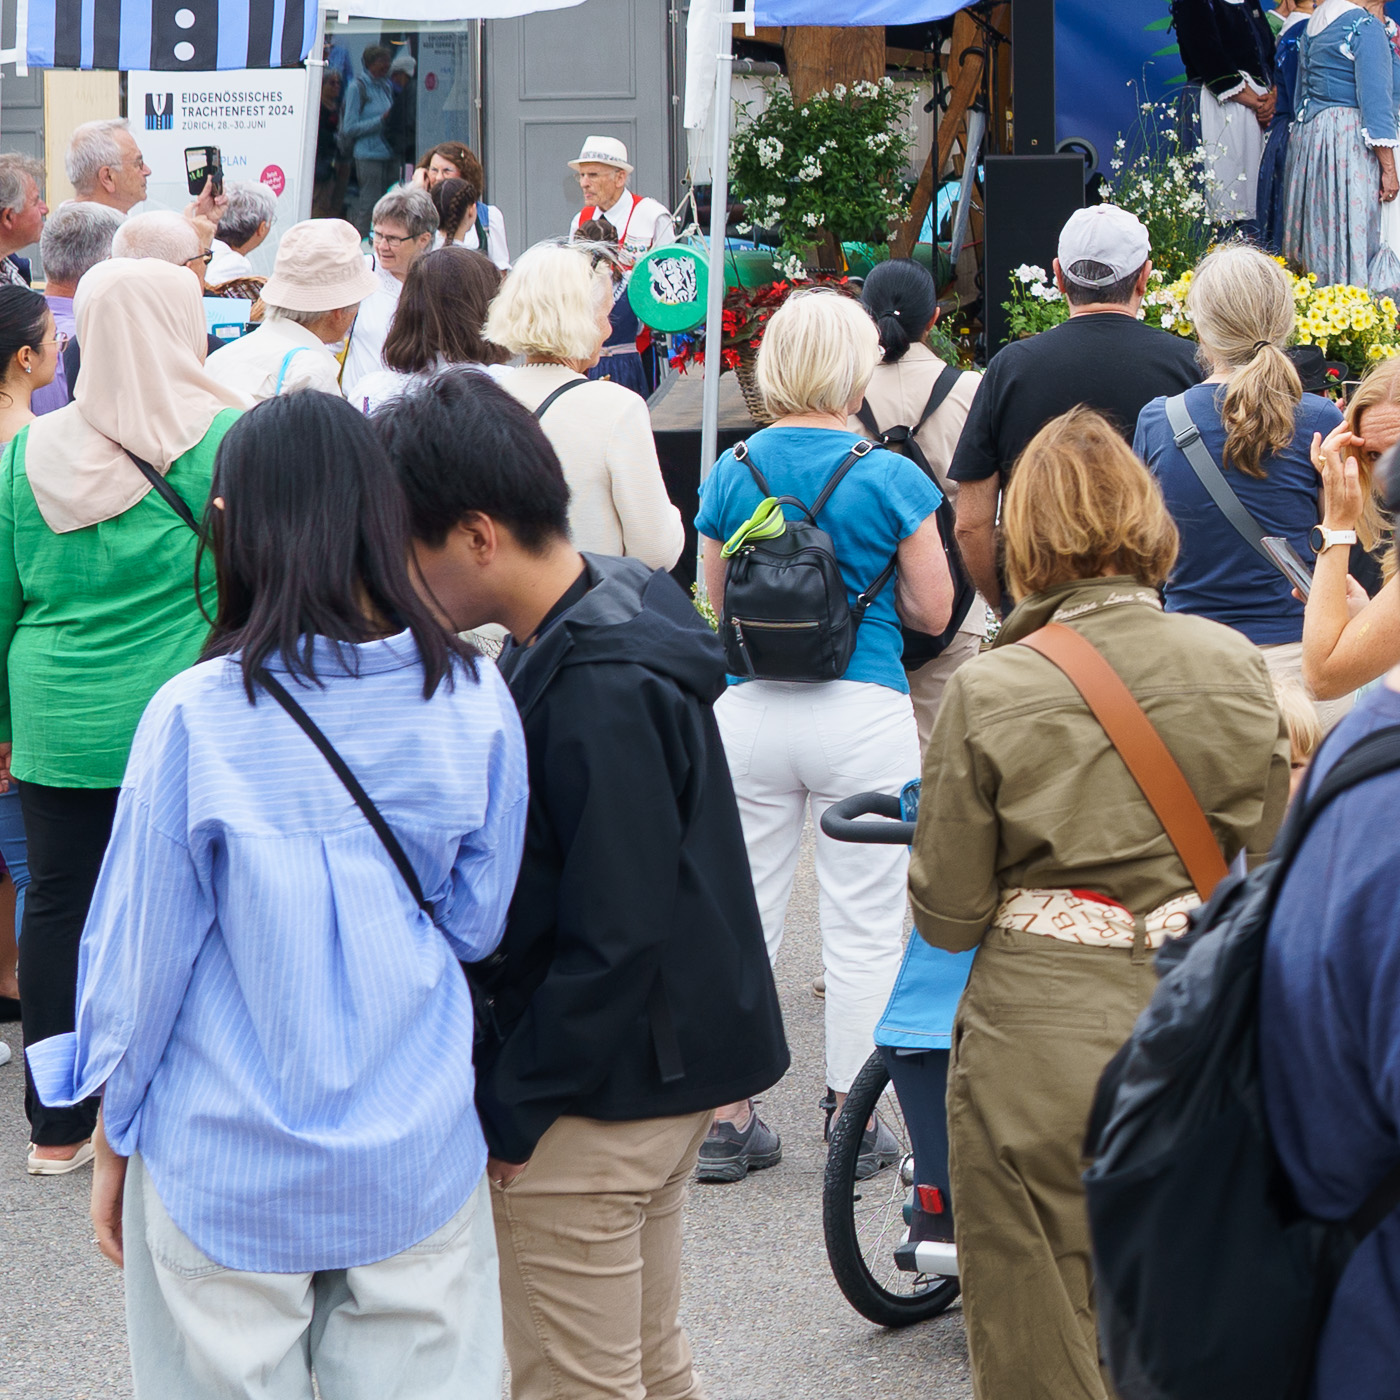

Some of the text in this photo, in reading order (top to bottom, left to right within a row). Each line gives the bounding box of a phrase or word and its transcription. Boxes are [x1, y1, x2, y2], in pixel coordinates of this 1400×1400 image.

[182, 90, 283, 103] EIDGENÖSSISCHES
[182, 105, 294, 117] TRACHTENFEST 2024
[182, 120, 216, 131] ZÜRICH,
[220, 155, 247, 166] PLAN
